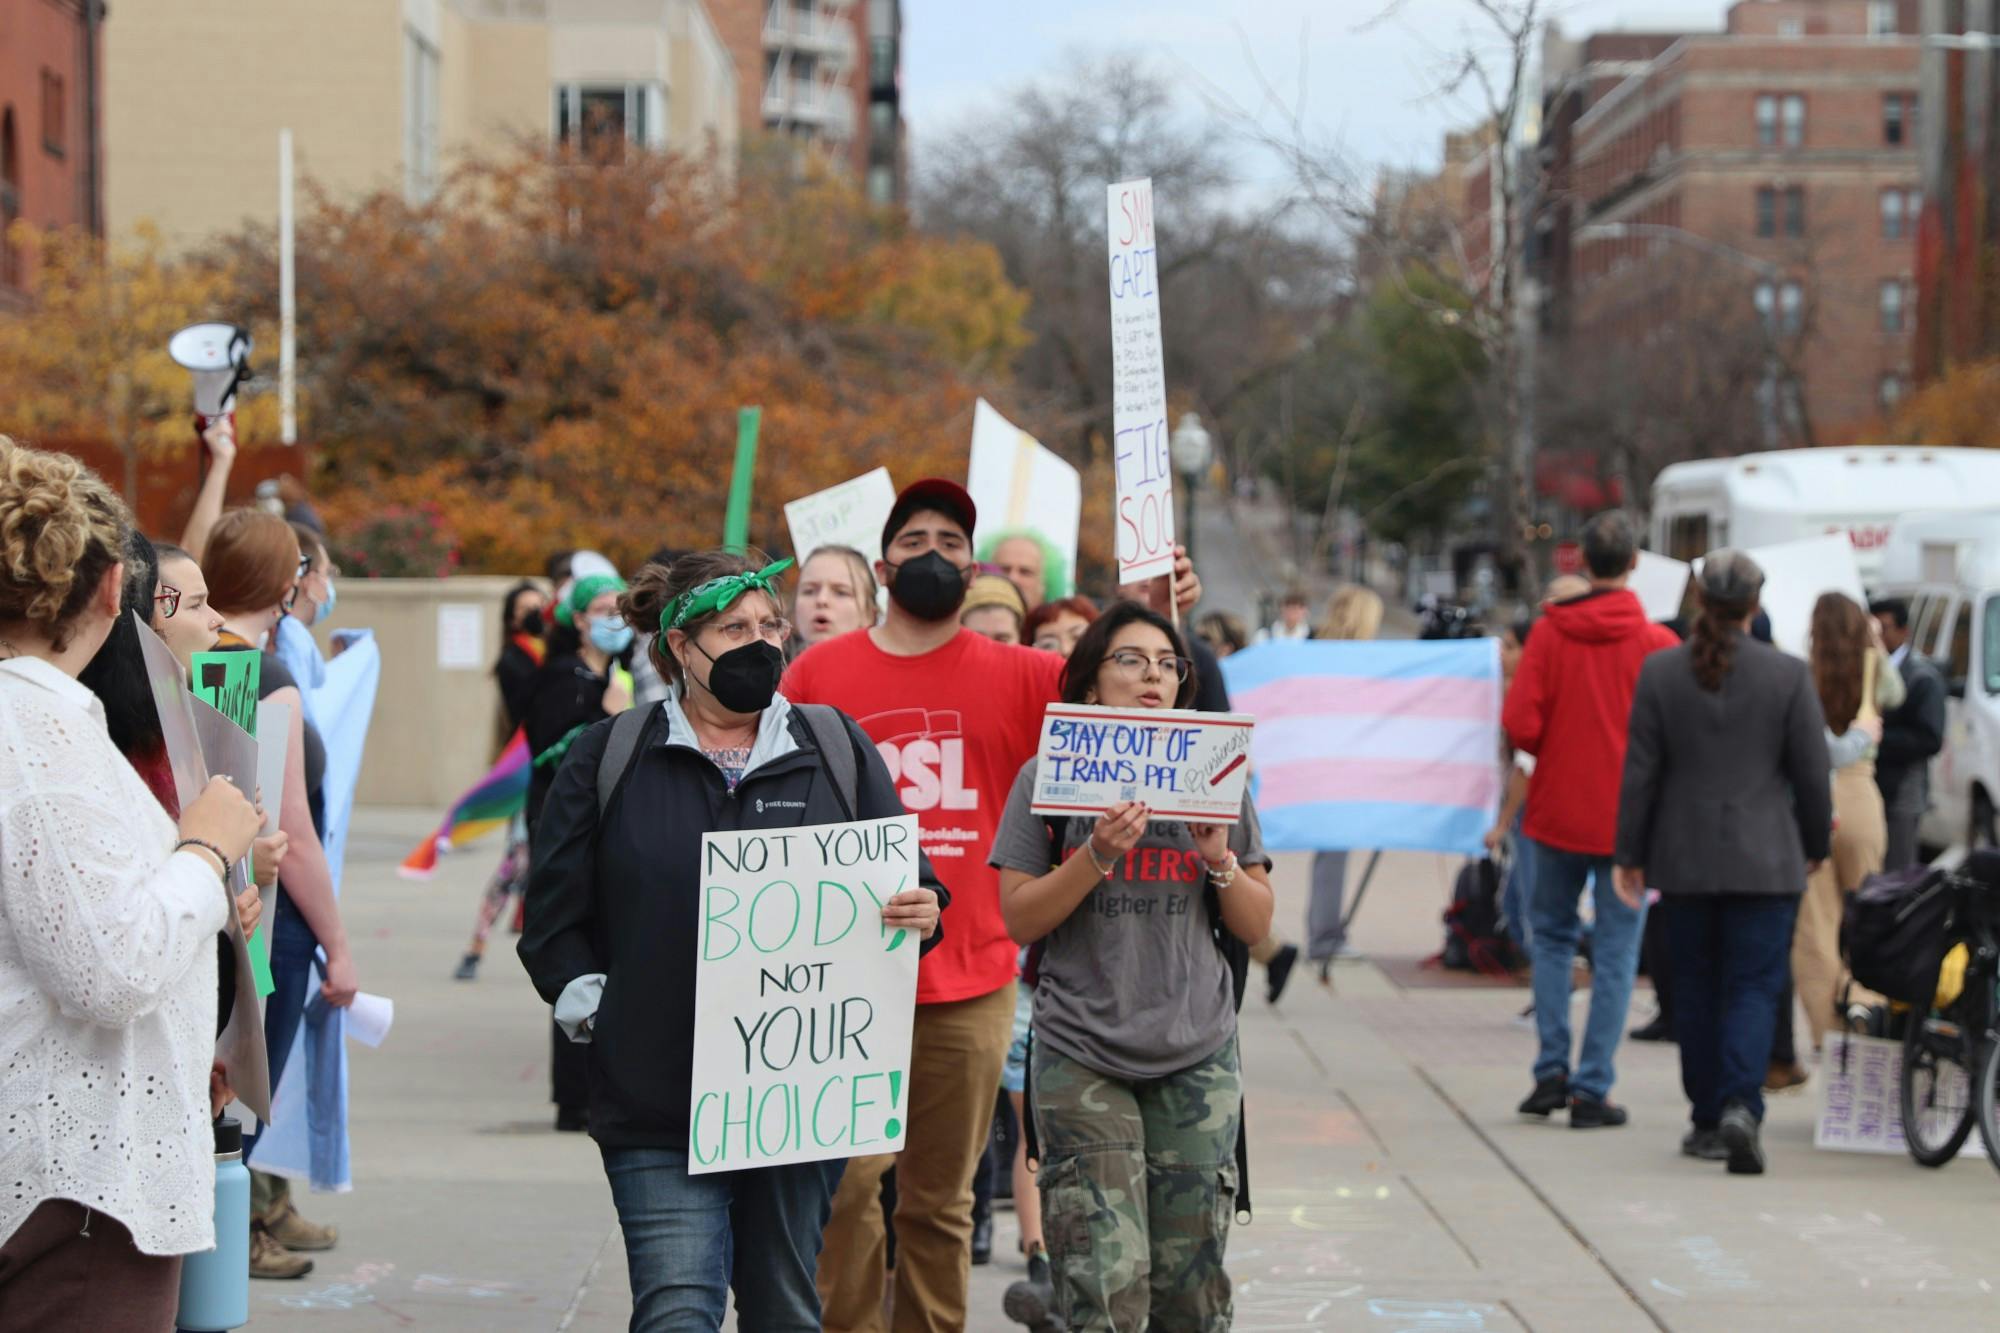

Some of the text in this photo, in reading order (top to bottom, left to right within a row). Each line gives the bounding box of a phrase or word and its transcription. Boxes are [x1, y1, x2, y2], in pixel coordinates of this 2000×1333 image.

[1050, 719, 1107, 758] STAY
[1113, 724, 1158, 758] OUT
[1166, 728, 1202, 762] OF
[1048, 756, 1184, 793] TRANS PPL
[707, 823, 908, 876] NOT YOUR
[704, 874, 907, 961] BODY,
[1165, 894, 1189, 915] Ed
[760, 962, 833, 998] NOT
[733, 997, 873, 1075] YOUR
[692, 1069, 903, 1166] CHOICE!
